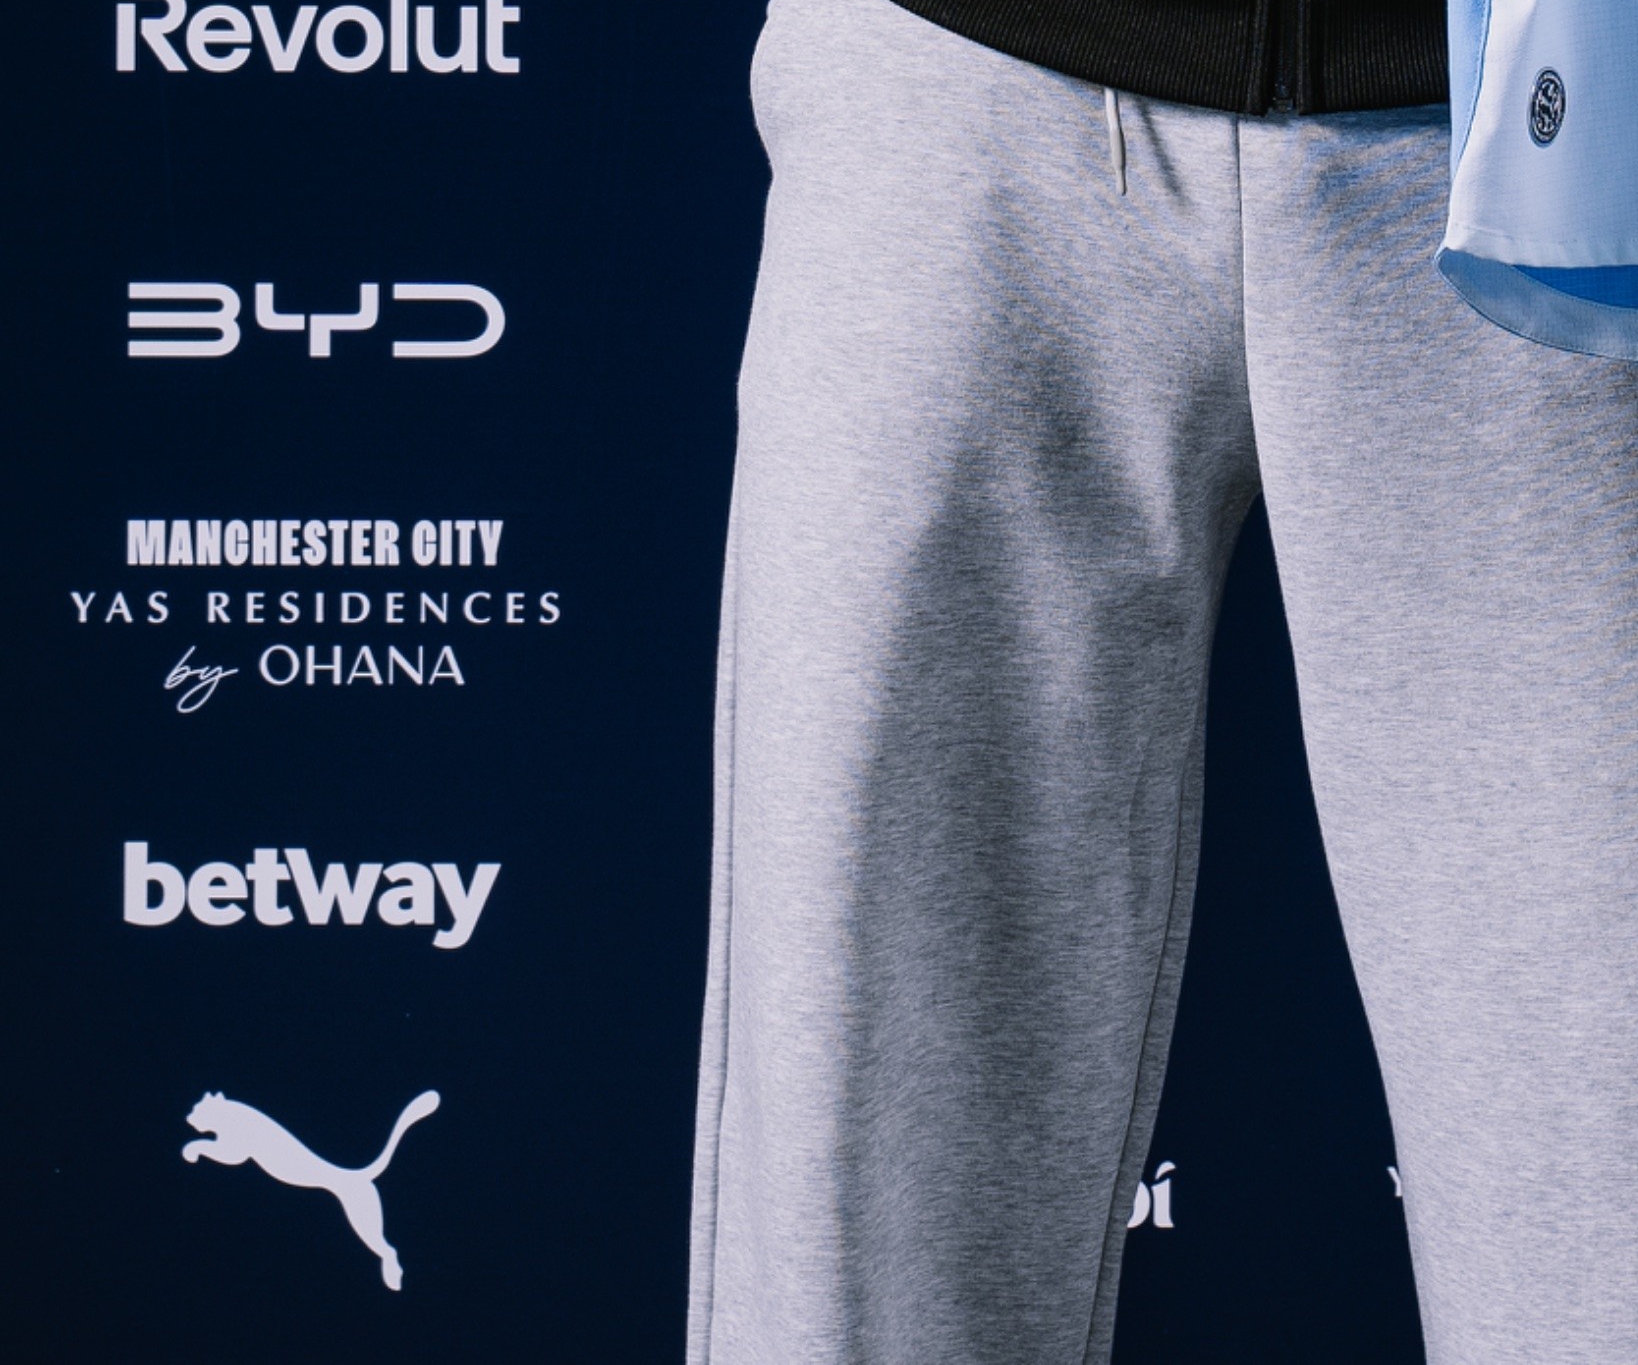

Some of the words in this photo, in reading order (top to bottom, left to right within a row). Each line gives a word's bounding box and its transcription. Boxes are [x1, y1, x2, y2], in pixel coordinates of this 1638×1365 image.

[128, 282, 505, 358] BYD
[127, 520, 400, 566] MANCHESTER
[412, 520, 503, 566] CITY
[71, 591, 169, 623] YAS
[208, 591, 560, 624] RESIDENCES
[164, 646, 238, 713] by
[259, 644, 465, 686] OHANA
[123, 841, 501, 949] betway
